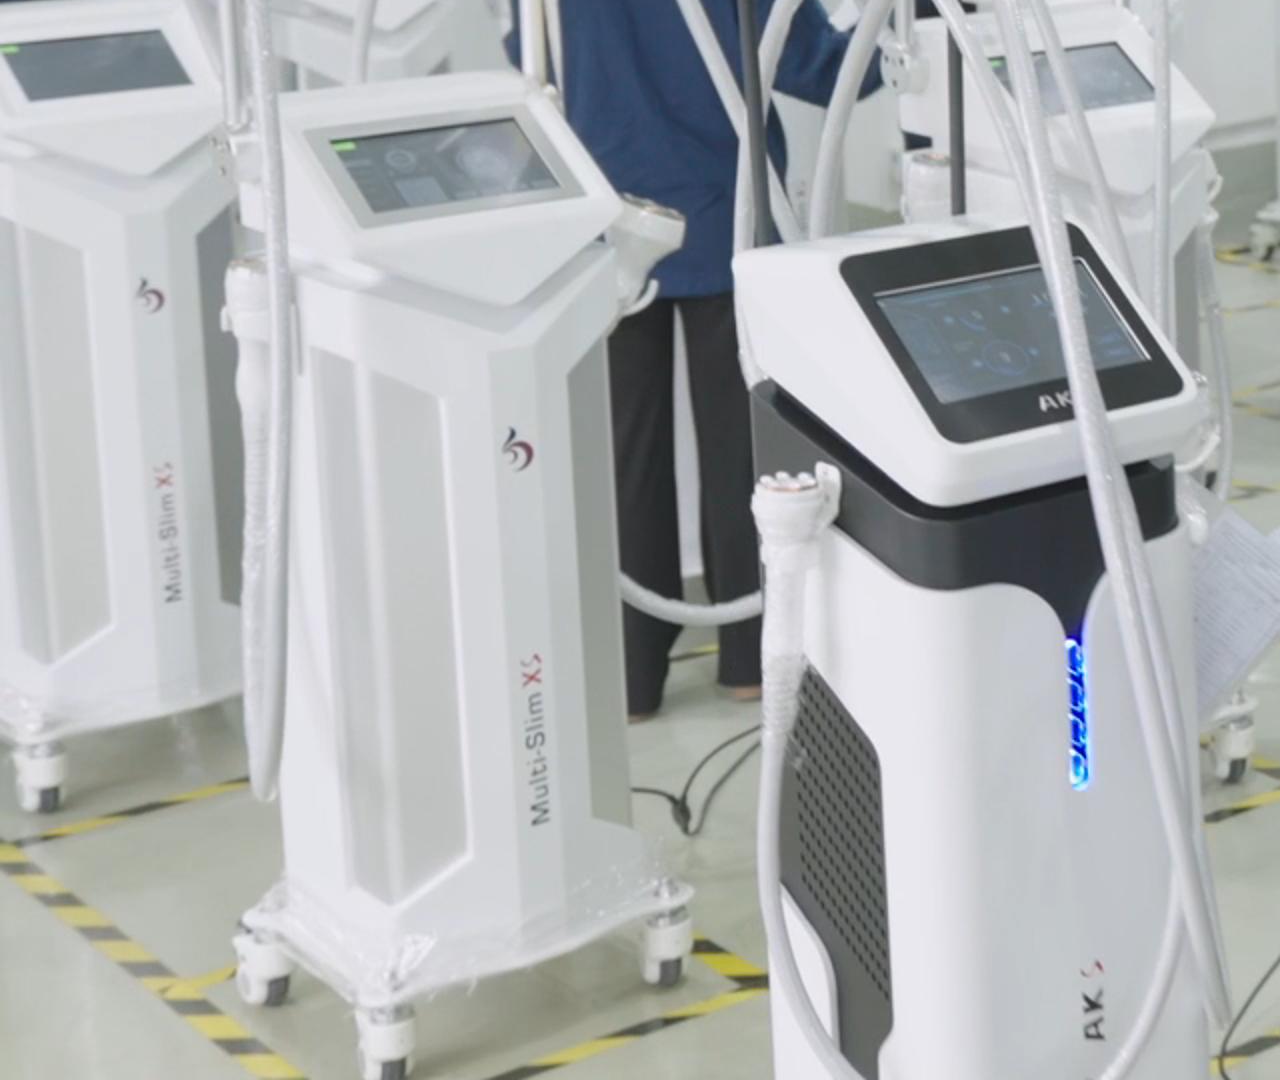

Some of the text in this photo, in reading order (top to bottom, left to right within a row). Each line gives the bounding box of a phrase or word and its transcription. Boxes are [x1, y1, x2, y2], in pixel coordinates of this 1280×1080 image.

[1038, 390, 1074, 412] AK
[158, 493, 182, 604] Multi-Slim
[520, 653, 550, 827] Multi-Slim XS
